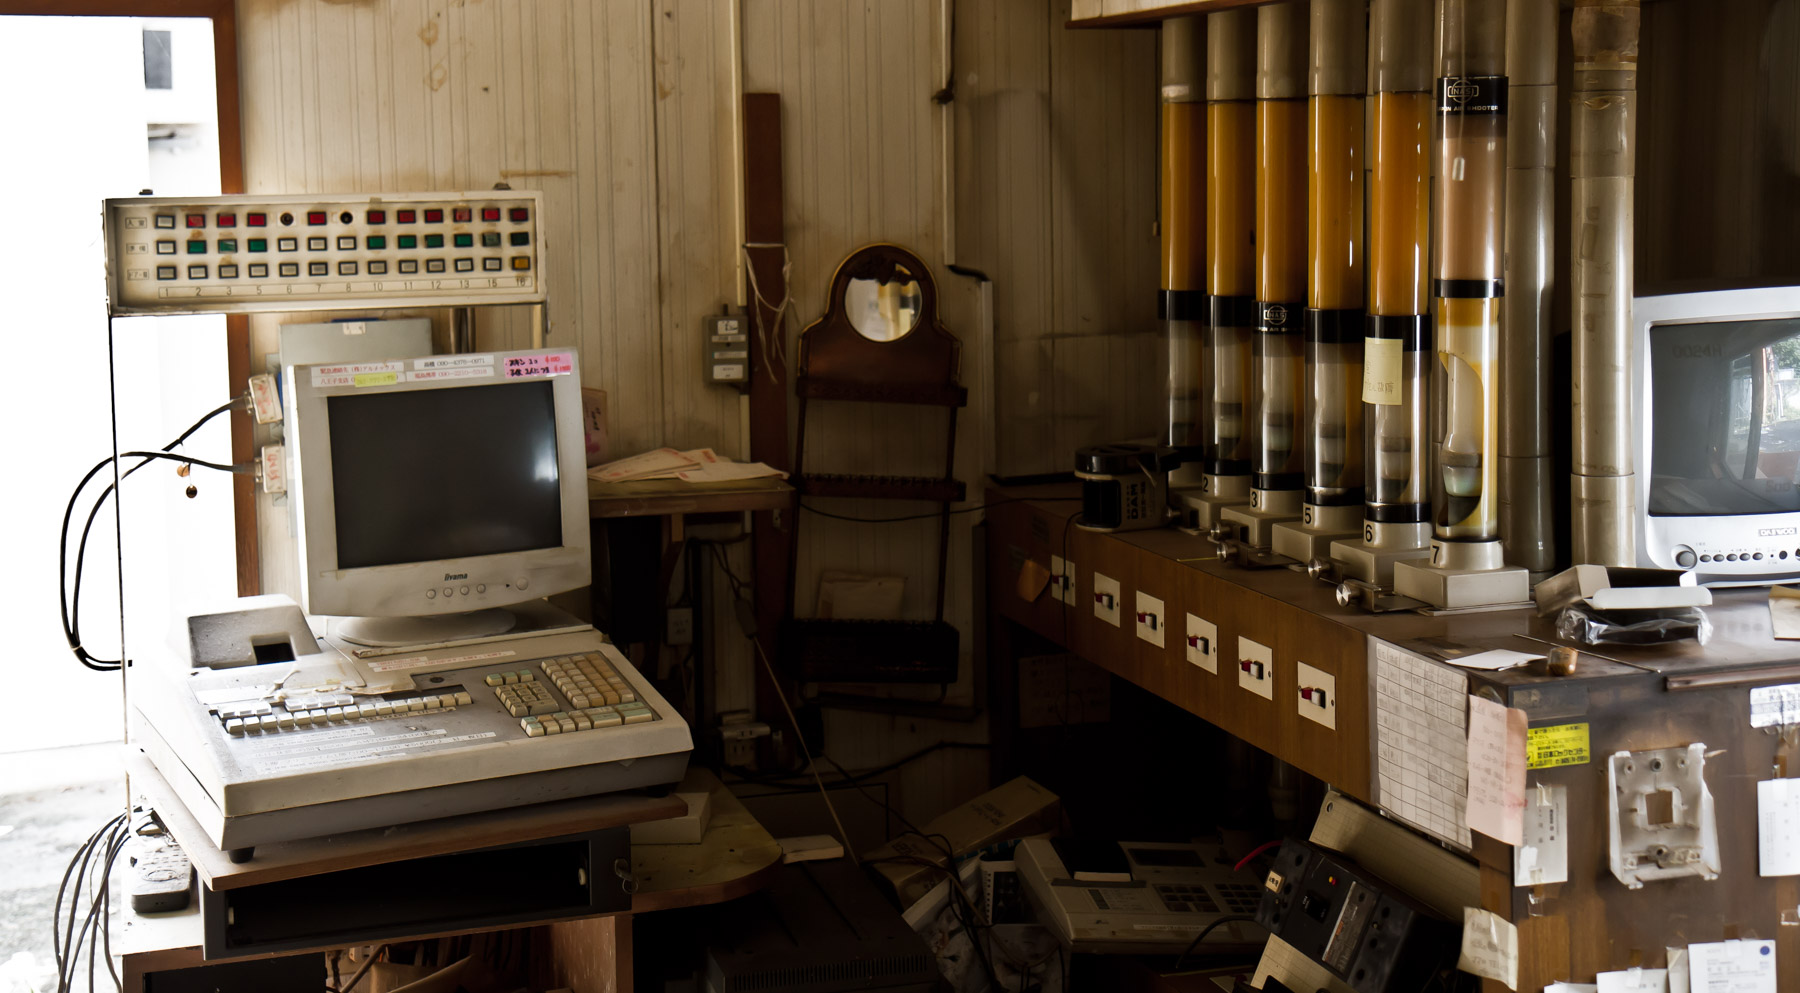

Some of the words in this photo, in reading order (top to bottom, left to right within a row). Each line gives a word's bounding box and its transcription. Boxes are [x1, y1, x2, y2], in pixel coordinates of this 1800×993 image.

[165, 287, 169, 297] 1
[195, 287, 202, 297] 2
[226, 287, 232, 296] 3
[256, 286, 262, 295] 5
[287, 285, 292, 294] 6
[316, 284, 322, 293] 7
[345, 283, 351, 292] 8
[373, 282, 383, 291] 10
[404, 281, 413, 290] 11
[431, 280, 441, 289] 12
[460, 280, 470, 288] 13
[487, 279, 498, 288] 15
[1203, 477, 1209, 493] 2
[1251, 492, 1258, 508] 3
[1304, 507, 1312, 525] 5
[1365, 524, 1373, 543] 6
[1432, 545, 1440, 564] 7
